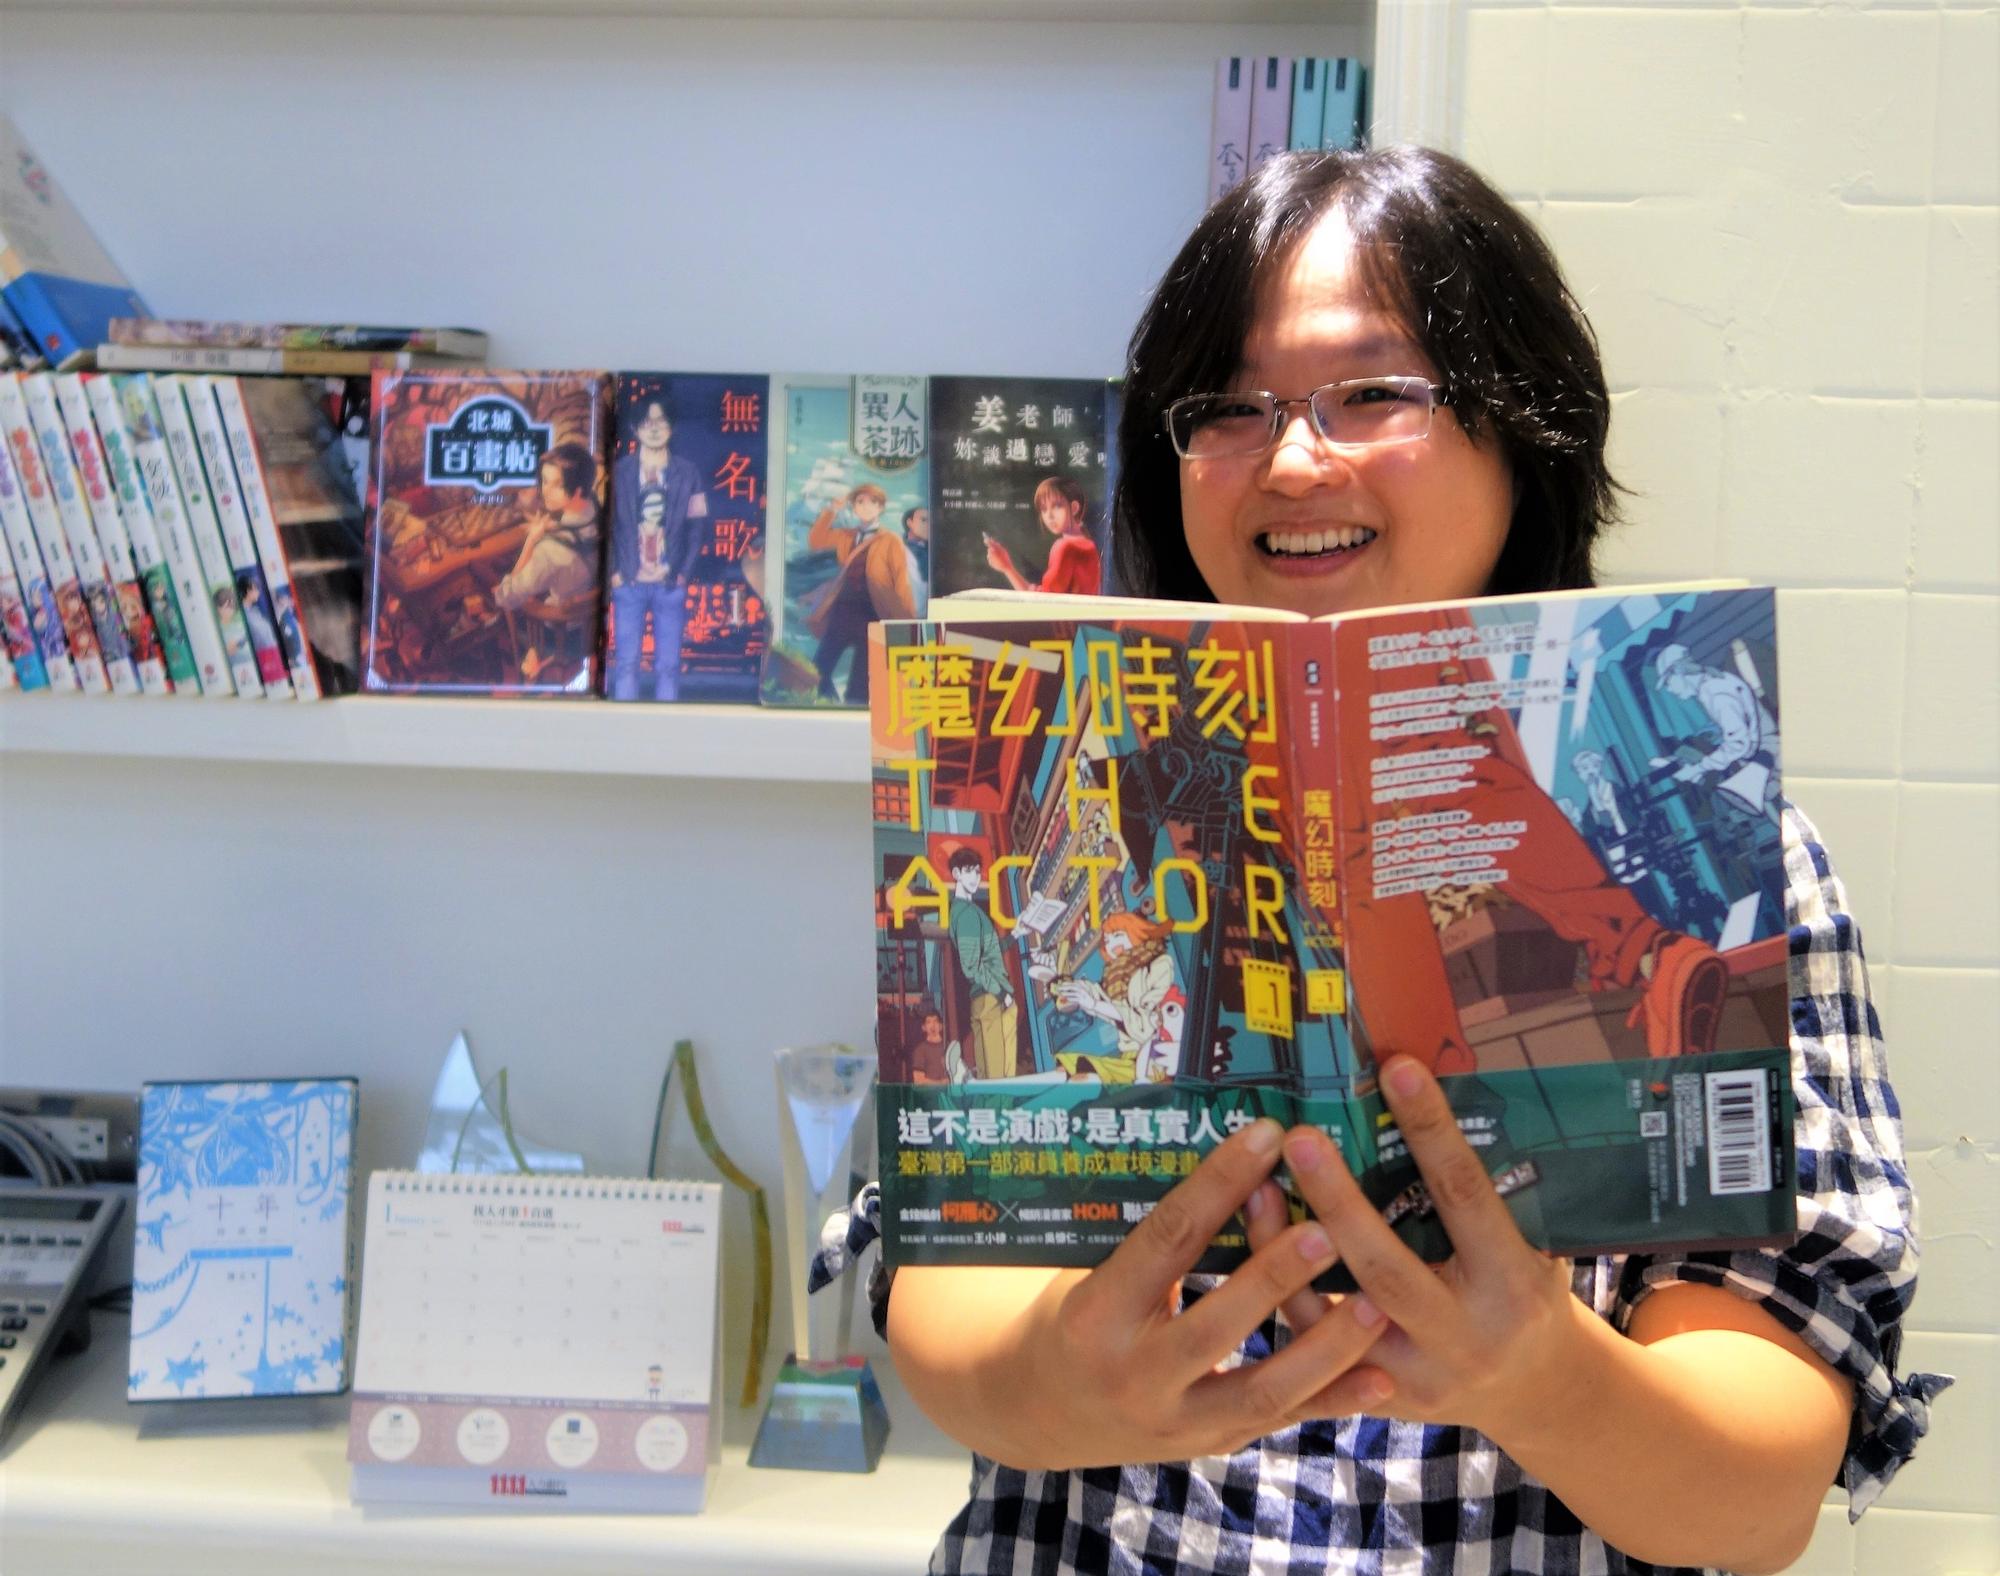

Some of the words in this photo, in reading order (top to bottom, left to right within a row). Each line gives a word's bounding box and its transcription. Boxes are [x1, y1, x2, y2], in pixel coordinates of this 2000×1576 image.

[862, 391, 919, 422] 異人
[862, 425, 920, 455] 茶跡
[441, 438, 537, 473] 百畫帖
[713, 389, 763, 562] 無名歌
[885, 637, 1278, 743] 魔幻時刻
[890, 757, 1283, 843] THE
[1304, 789, 1337, 909] 魔幻時刻
[893, 854, 1289, 945] ACTOR
[1072, 1202, 1118, 1221] HOM
